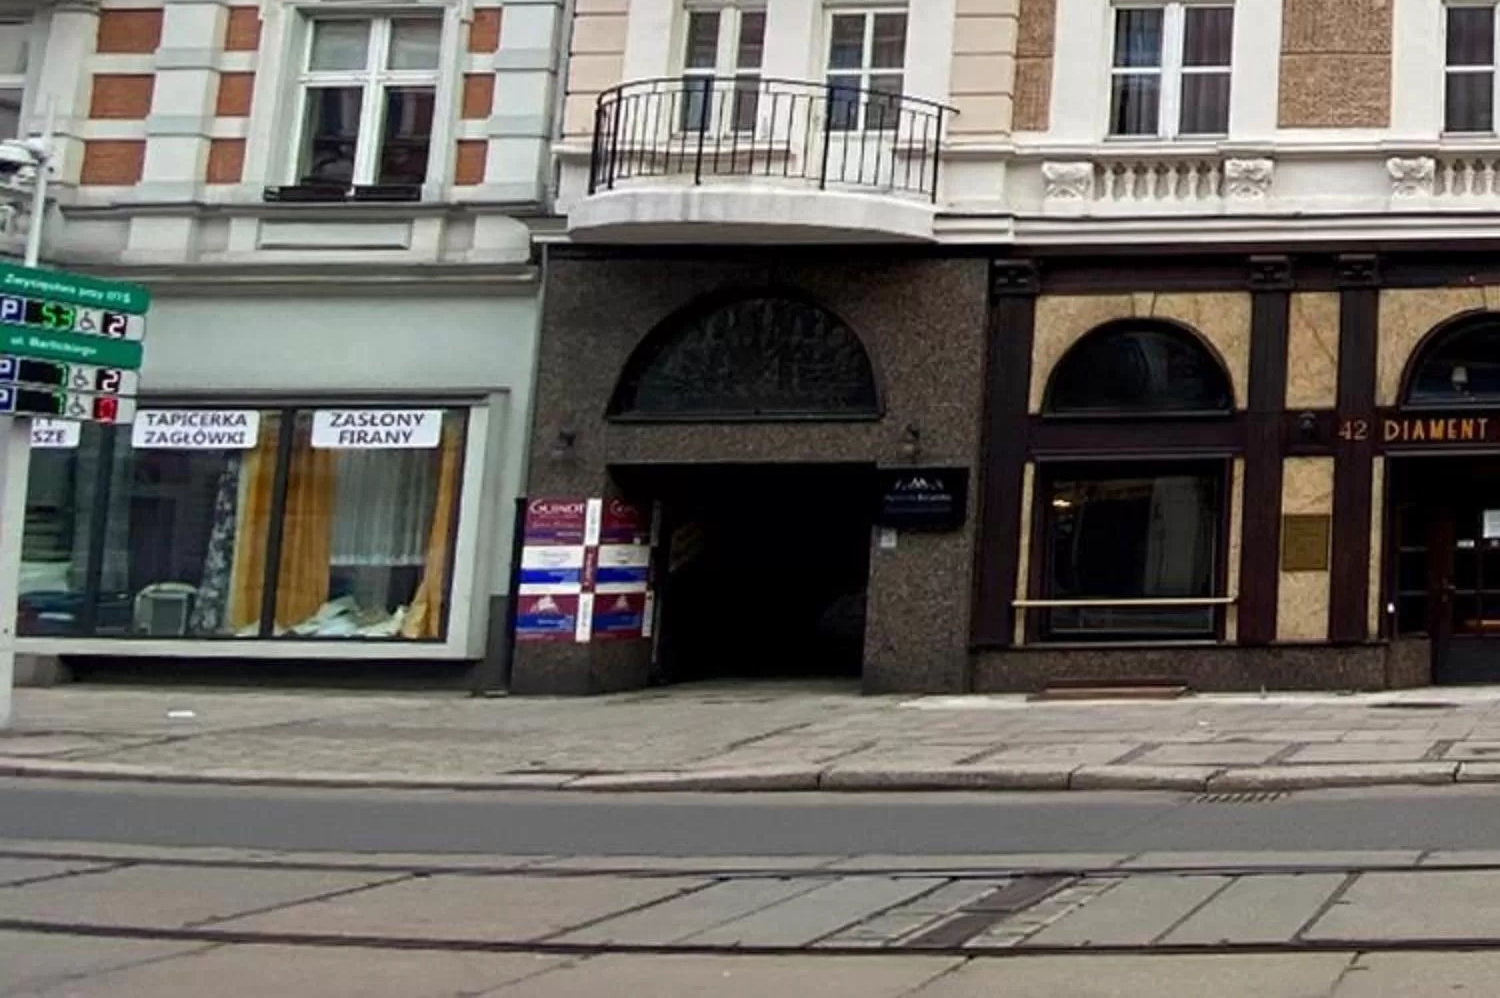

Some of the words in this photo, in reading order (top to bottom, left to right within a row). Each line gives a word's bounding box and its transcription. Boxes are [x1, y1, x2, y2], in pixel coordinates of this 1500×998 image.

[1, 300, 18, 319] P
[108, 315, 125, 336] 2
[102, 369, 118, 391] 2
[146, 412, 247, 427] TAPICERKA
[329, 412, 425, 427] ZASŁONY
[144, 428, 245, 445] ZAGŁÓWKI
[338, 429, 413, 445] FIRANY
[1338, 420, 1369, 441] 42
[1383, 418, 1488, 441] DIAMENT
